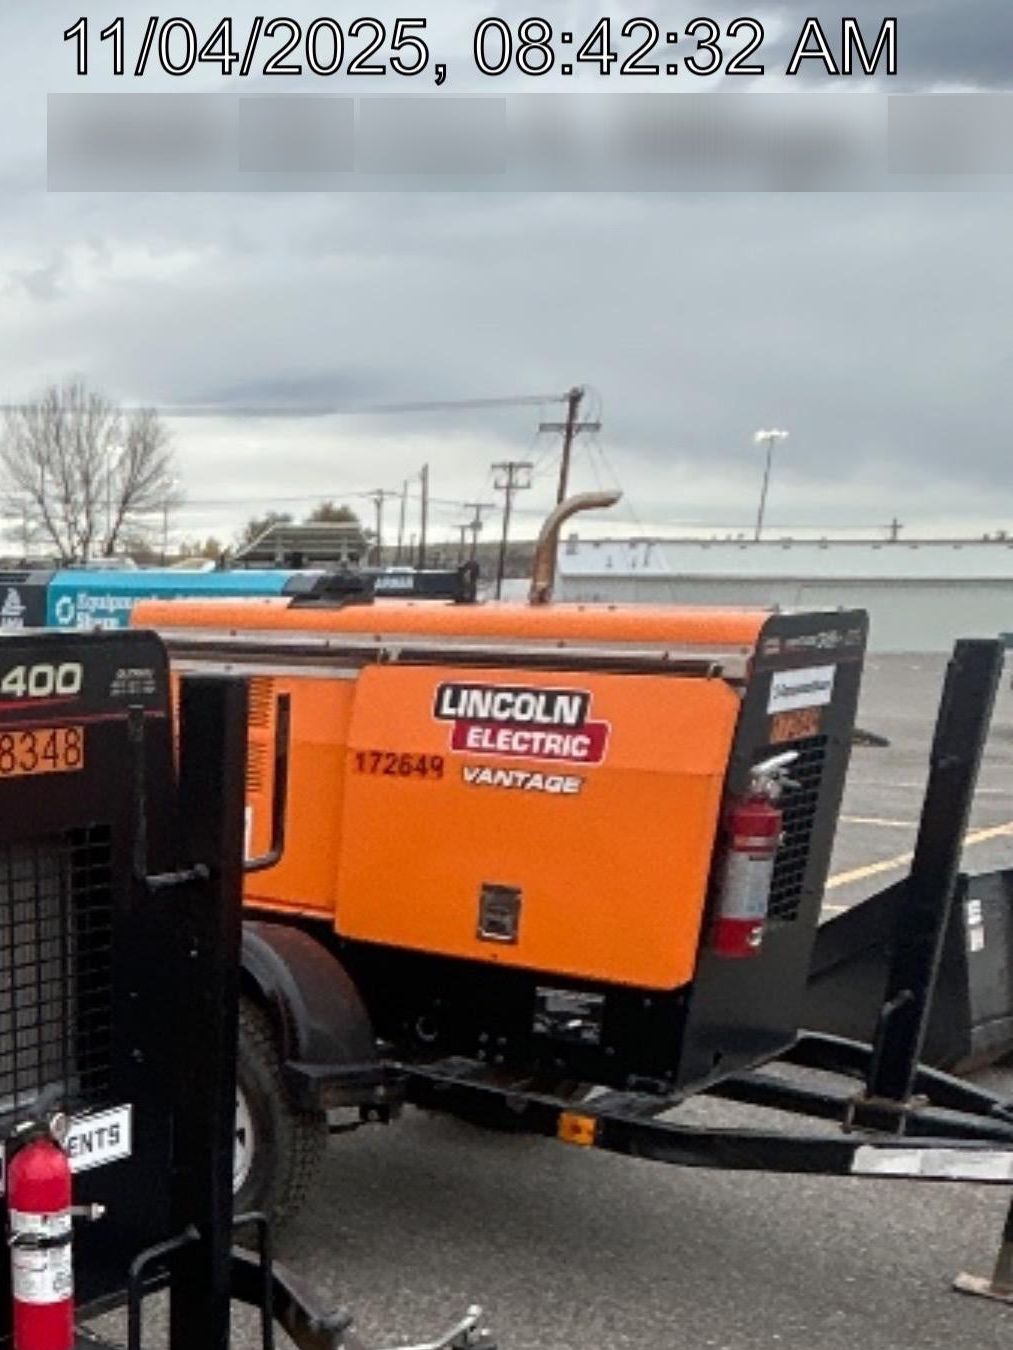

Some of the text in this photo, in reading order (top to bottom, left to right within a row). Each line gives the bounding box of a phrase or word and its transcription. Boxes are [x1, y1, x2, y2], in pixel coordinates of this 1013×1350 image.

[441, 688, 583, 724] LINCOLN
[466, 725, 591, 757] ELECTRIC
[355, 752, 445, 779] 172649
[462, 766, 583, 794] VANTAGE
[68, 1124, 120, 1159] ENTS
